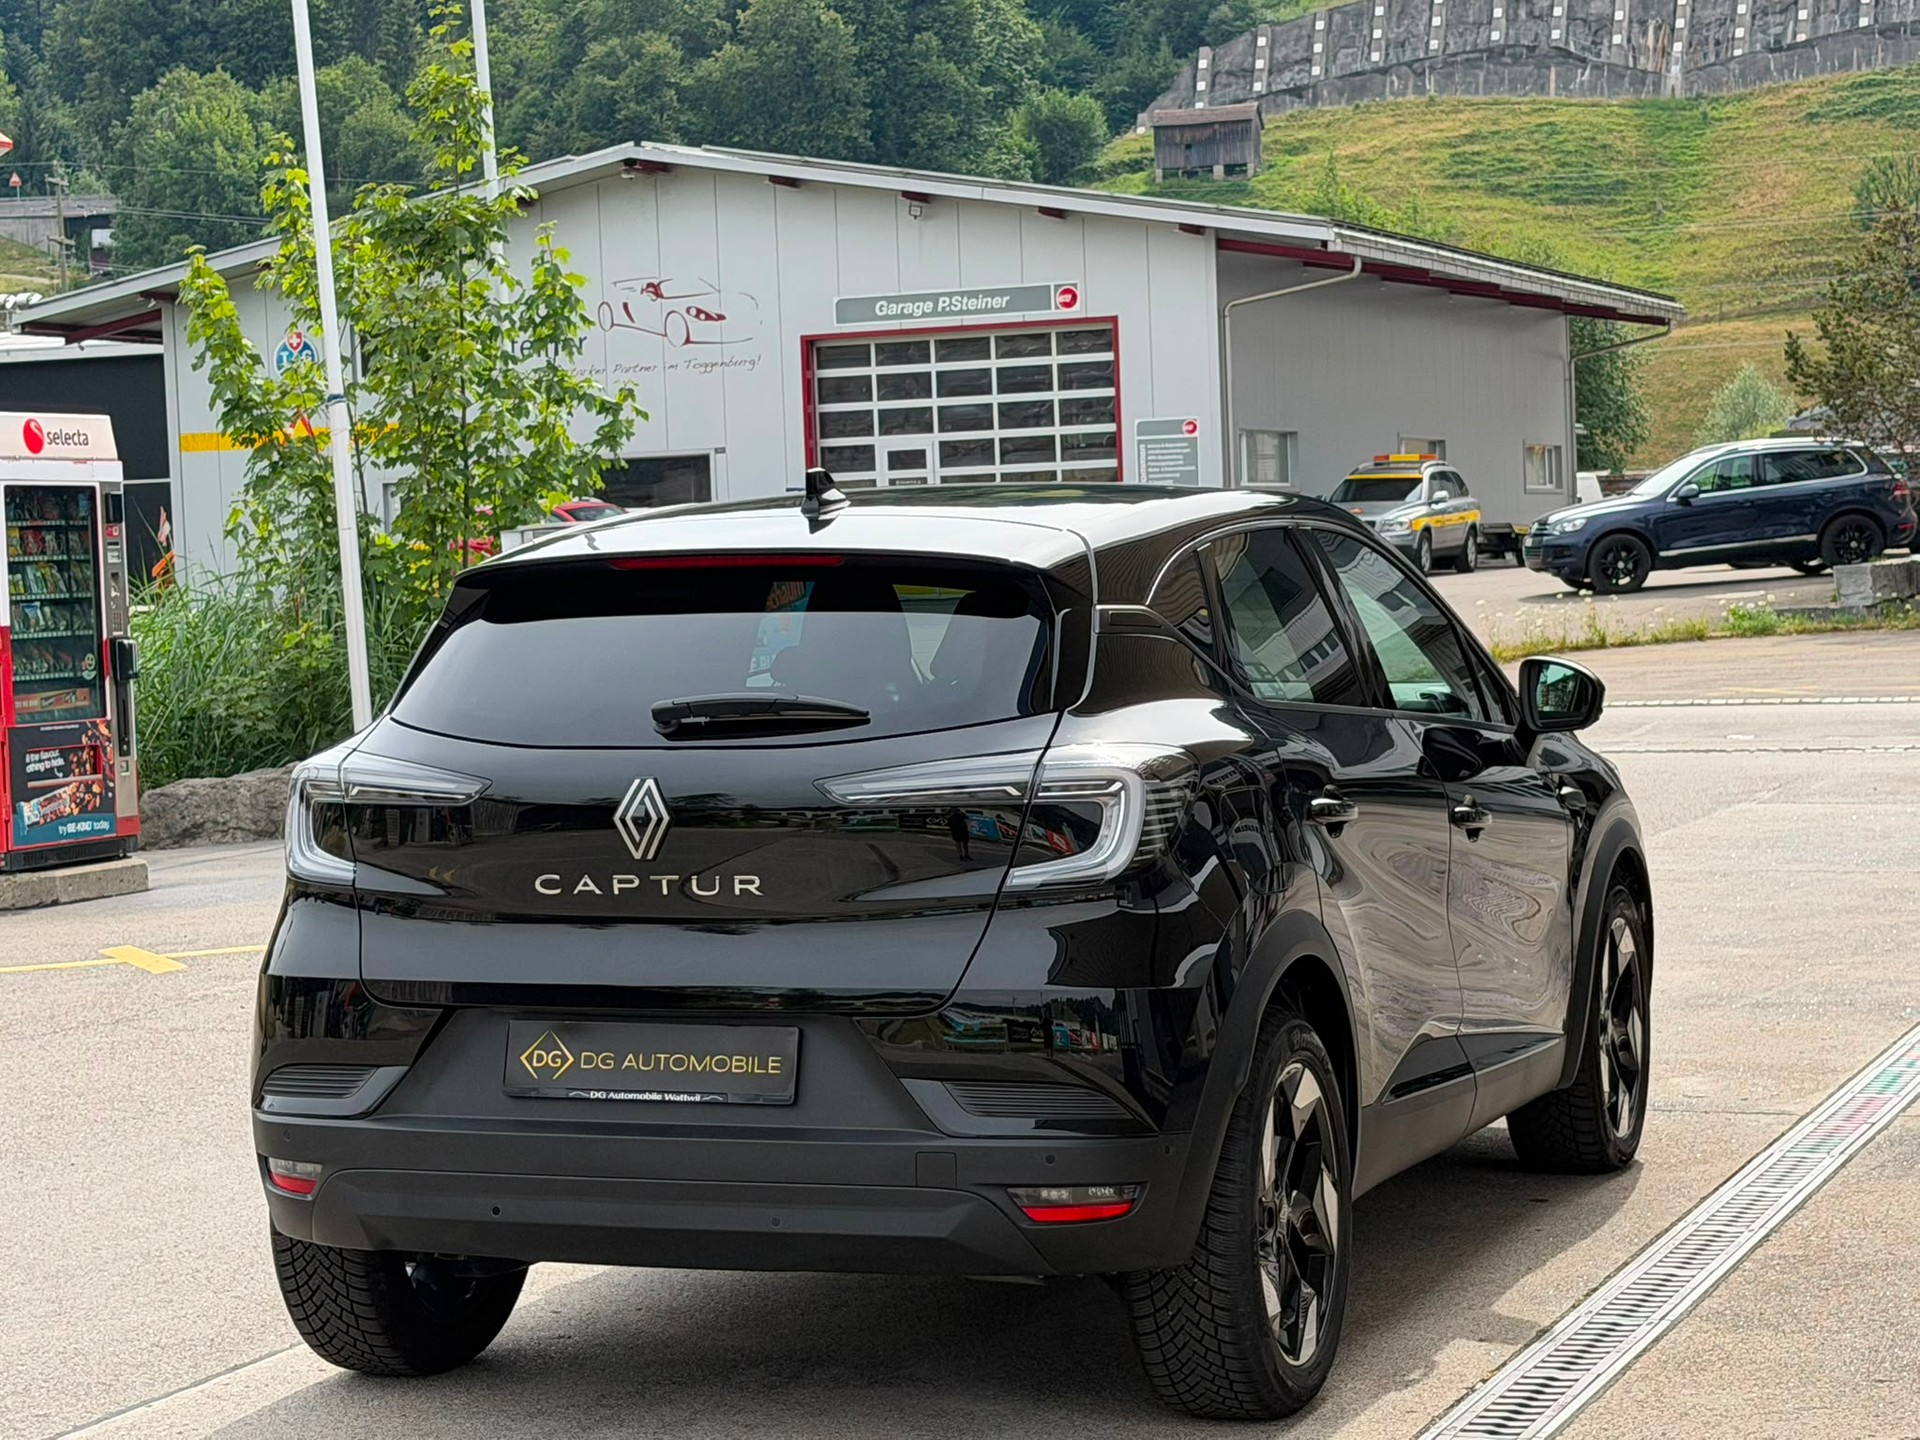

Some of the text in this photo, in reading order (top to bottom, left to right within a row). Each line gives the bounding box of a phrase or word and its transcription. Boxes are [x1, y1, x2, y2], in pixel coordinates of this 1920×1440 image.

[874, 300, 934, 317] Garage
[46, 428, 89, 447] selecta
[534, 874, 764, 896] CAPTUR
[532, 1050, 562, 1068] DG
[580, 1052, 782, 1074] DG AUTOMOBILE
[590, 1090, 701, 1102] DG Automobile Wattwil
